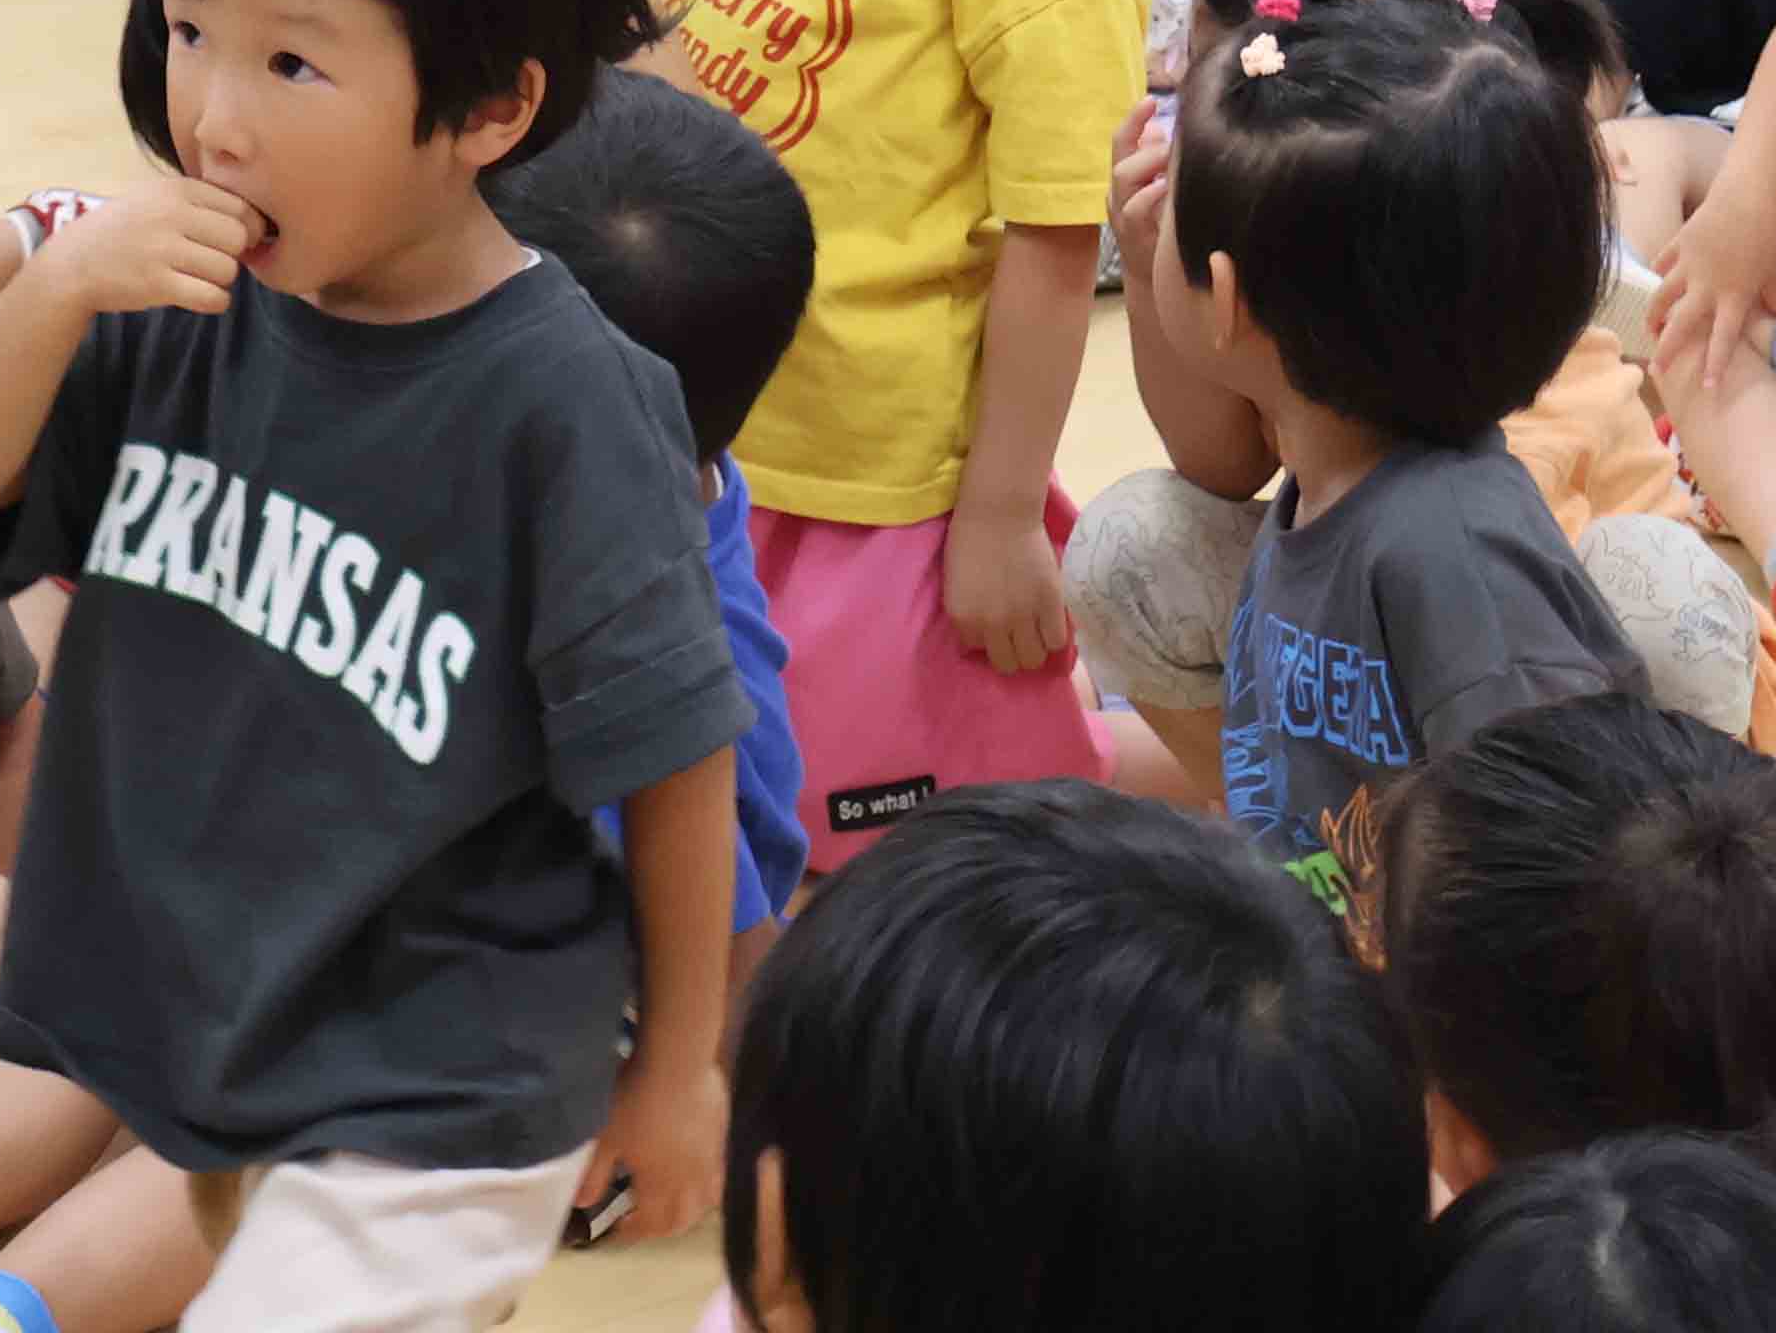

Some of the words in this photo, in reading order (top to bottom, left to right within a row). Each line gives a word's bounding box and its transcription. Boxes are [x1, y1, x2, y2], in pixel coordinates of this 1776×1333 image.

[85, 441, 477, 765] RKANSAS
[838, 799, 865, 821] So
[869, 789, 918, 815] what
